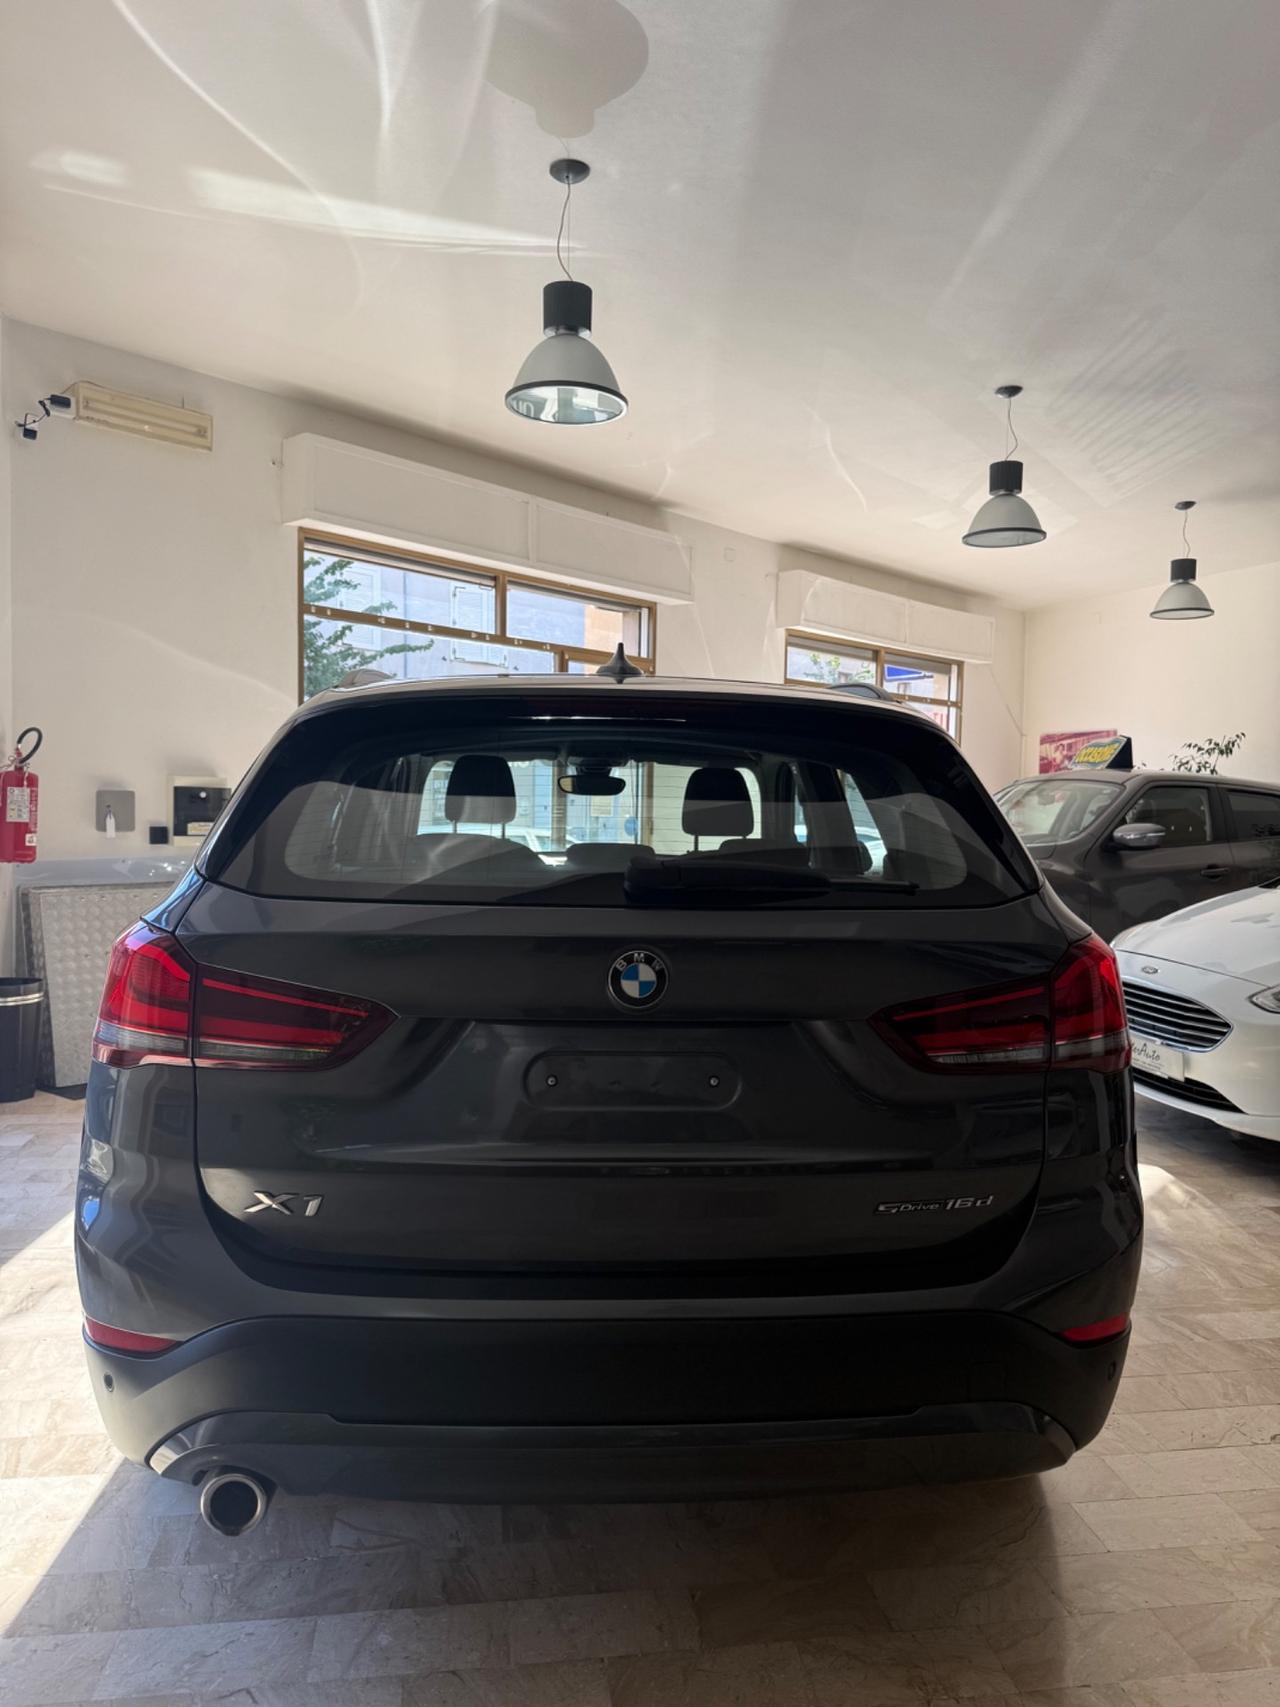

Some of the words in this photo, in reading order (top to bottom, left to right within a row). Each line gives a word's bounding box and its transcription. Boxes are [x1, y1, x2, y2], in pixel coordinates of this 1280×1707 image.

[615, 952, 664, 971] BMW
[243, 1192, 323, 1216] X1
[944, 1195, 994, 1210] 16d
